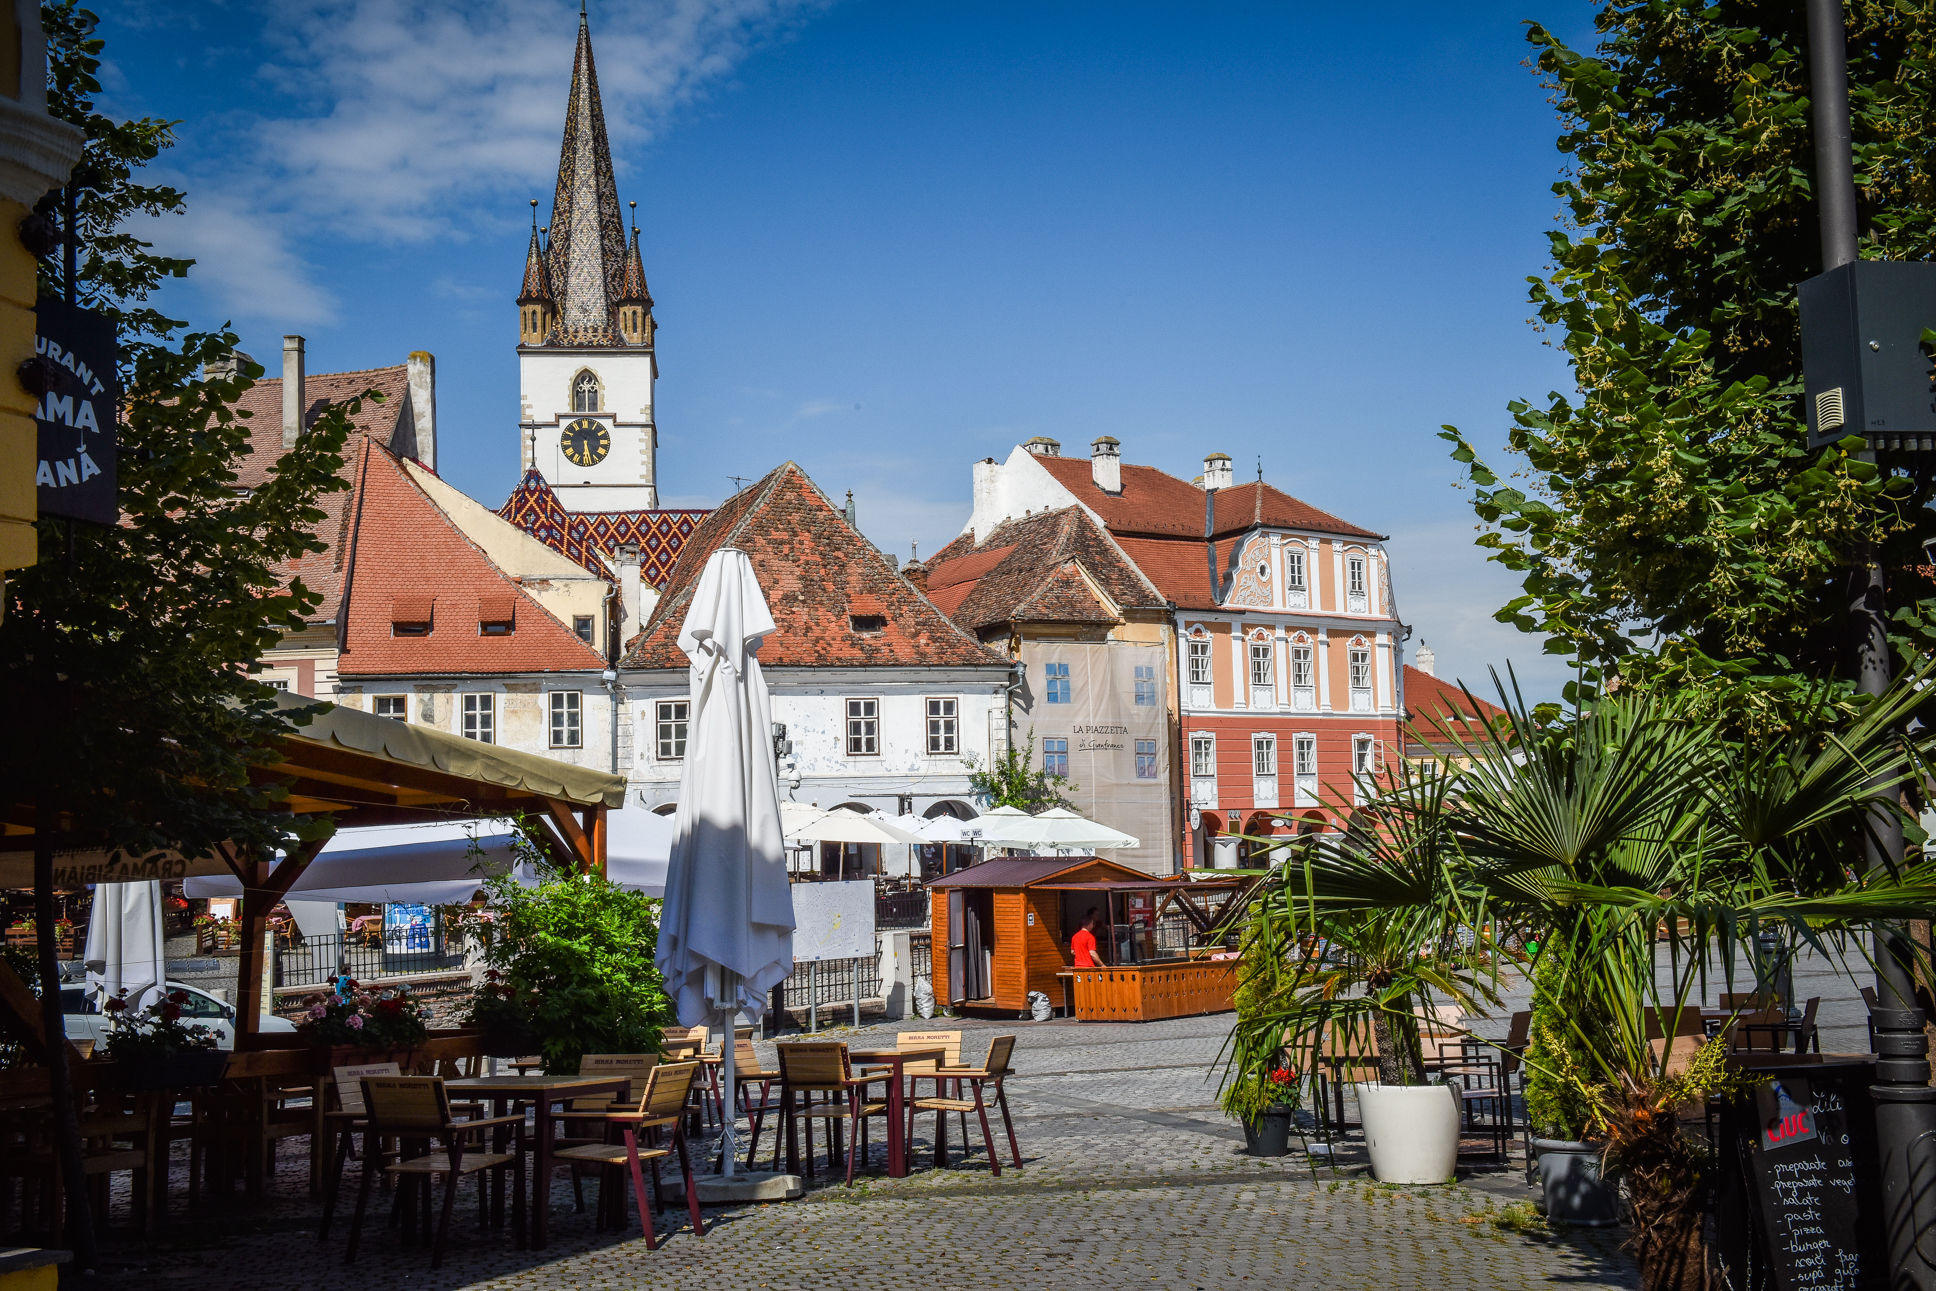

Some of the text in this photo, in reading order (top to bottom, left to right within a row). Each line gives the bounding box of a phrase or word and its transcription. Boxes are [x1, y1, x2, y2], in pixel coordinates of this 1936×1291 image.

[1073, 725, 1129, 735] LA PIAZZETTA
[972, 829, 982, 837] WC
